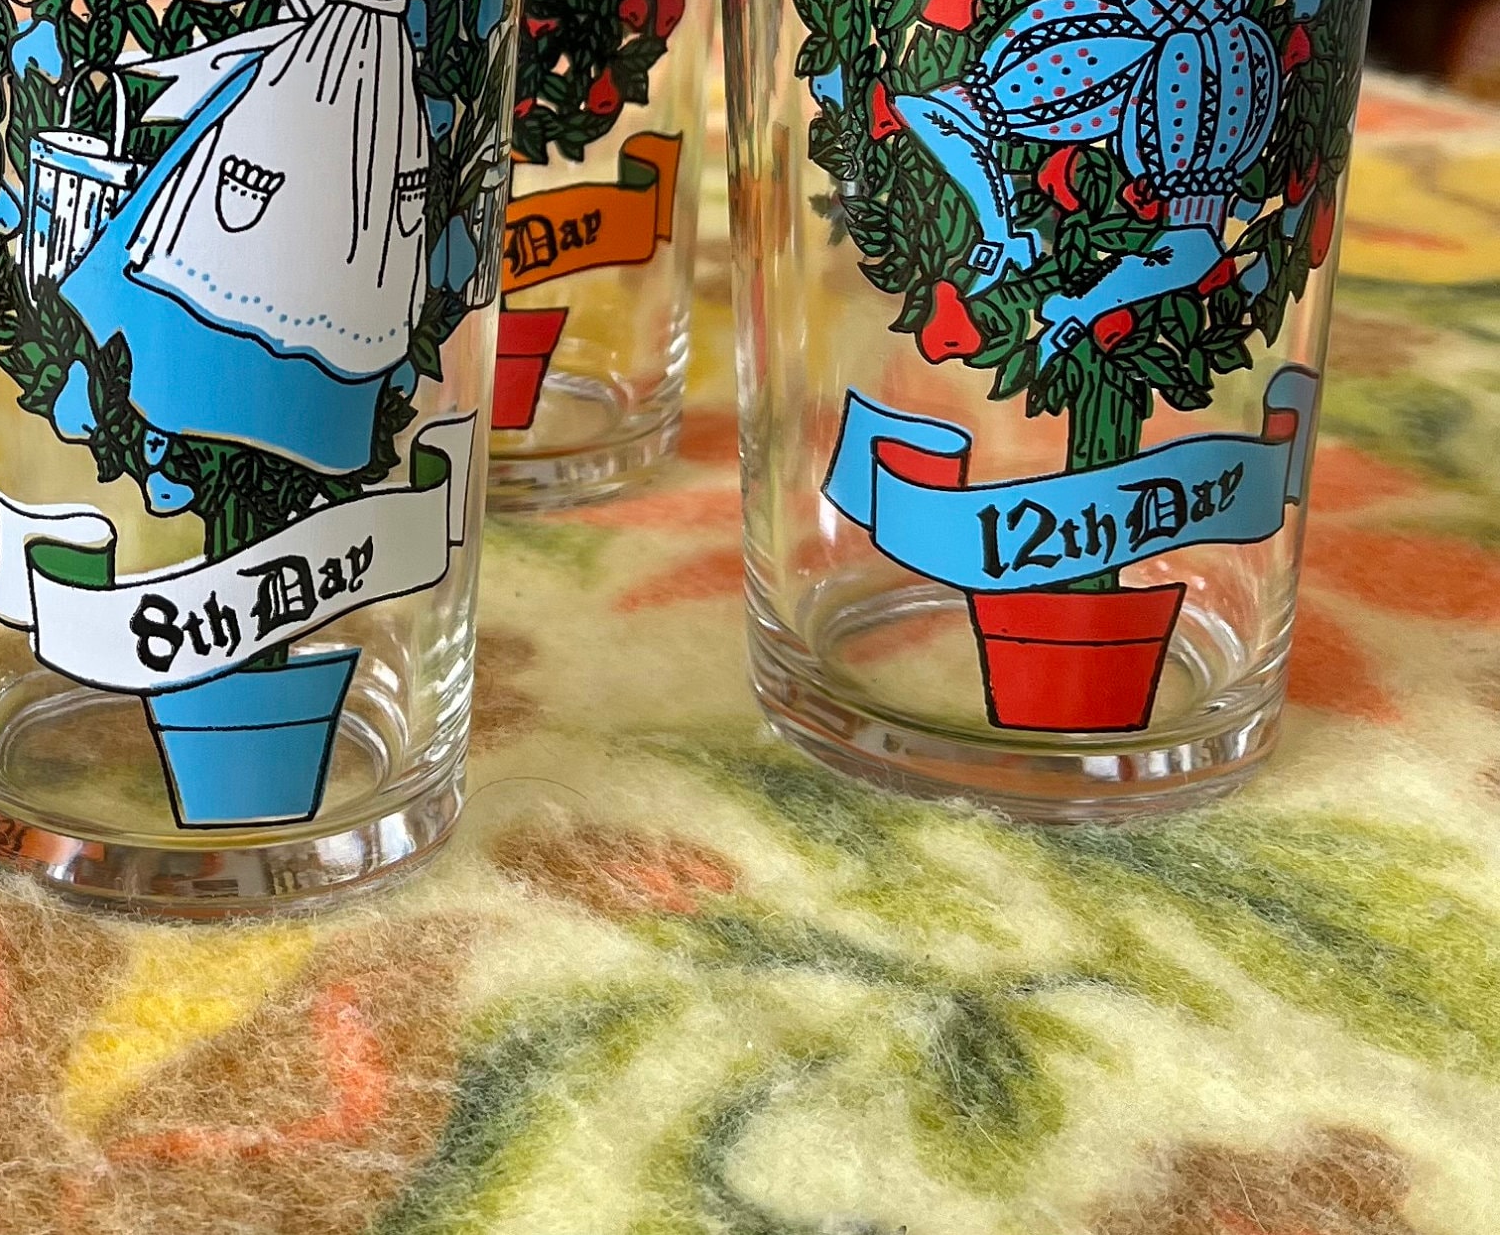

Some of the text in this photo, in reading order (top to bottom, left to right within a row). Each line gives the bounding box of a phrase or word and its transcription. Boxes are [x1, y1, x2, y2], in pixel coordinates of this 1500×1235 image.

[502, 209, 601, 278] Day
[977, 462, 1244, 579] 12th Day
[129, 535, 374, 672] 8th Day
